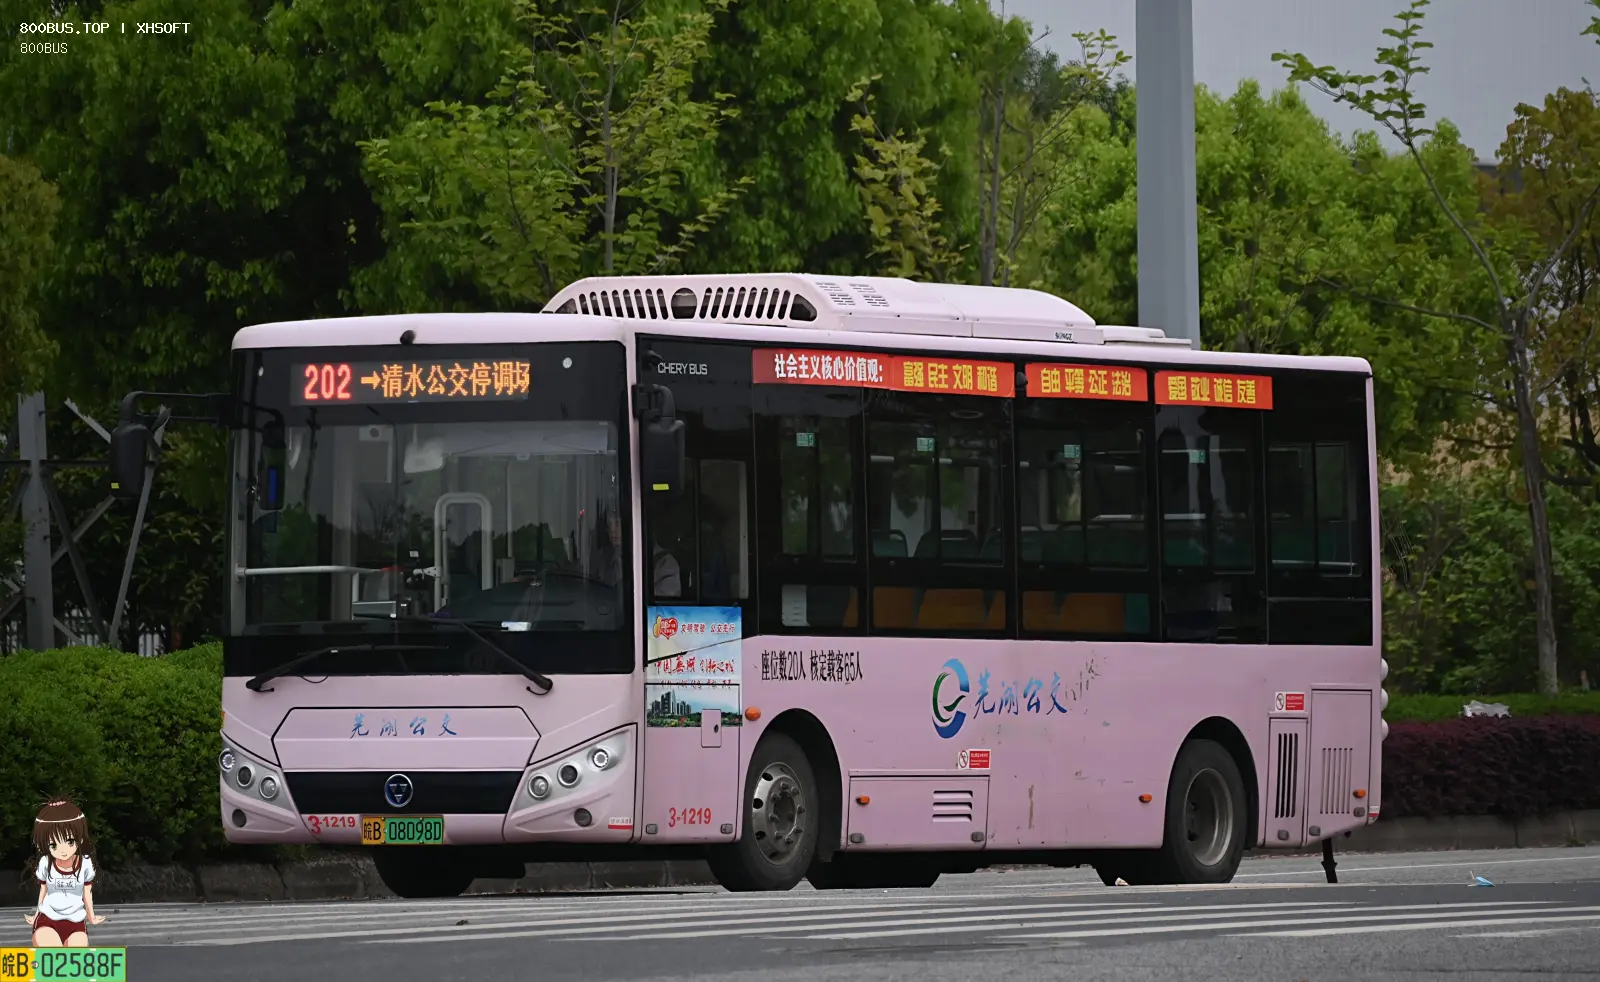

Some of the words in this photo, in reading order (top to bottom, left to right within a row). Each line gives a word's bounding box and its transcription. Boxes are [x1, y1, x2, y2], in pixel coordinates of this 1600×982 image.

[304, 364, 352, 400] 202
[657, 362, 688, 374] CHERY
[689, 363, 708, 376] BUS
[903, 361, 925, 388] 富强
[927, 362, 949, 389] 民主
[952, 364, 974, 390] 文明
[977, 365, 998, 392] 和谐
[1041, 368, 1061, 393] 自由
[1065, 368, 1085, 394] 平等
[1088, 369, 1108, 394] 公正
[1112, 370, 1132, 396] 法治
[1167, 376, 1187, 401] 爱国
[1190, 376, 1210, 402] 敬业
[1213, 378, 1233, 403] 诚信
[1237, 379, 1256, 404] 友善
[710, 622, 736, 634] 公交先行
[761, 649, 806, 681] 座位数20人
[810, 649, 863, 682] 核定载客65人
[307, 815, 356, 835] 3-1219
[668, 807, 712, 827] 3-1219
